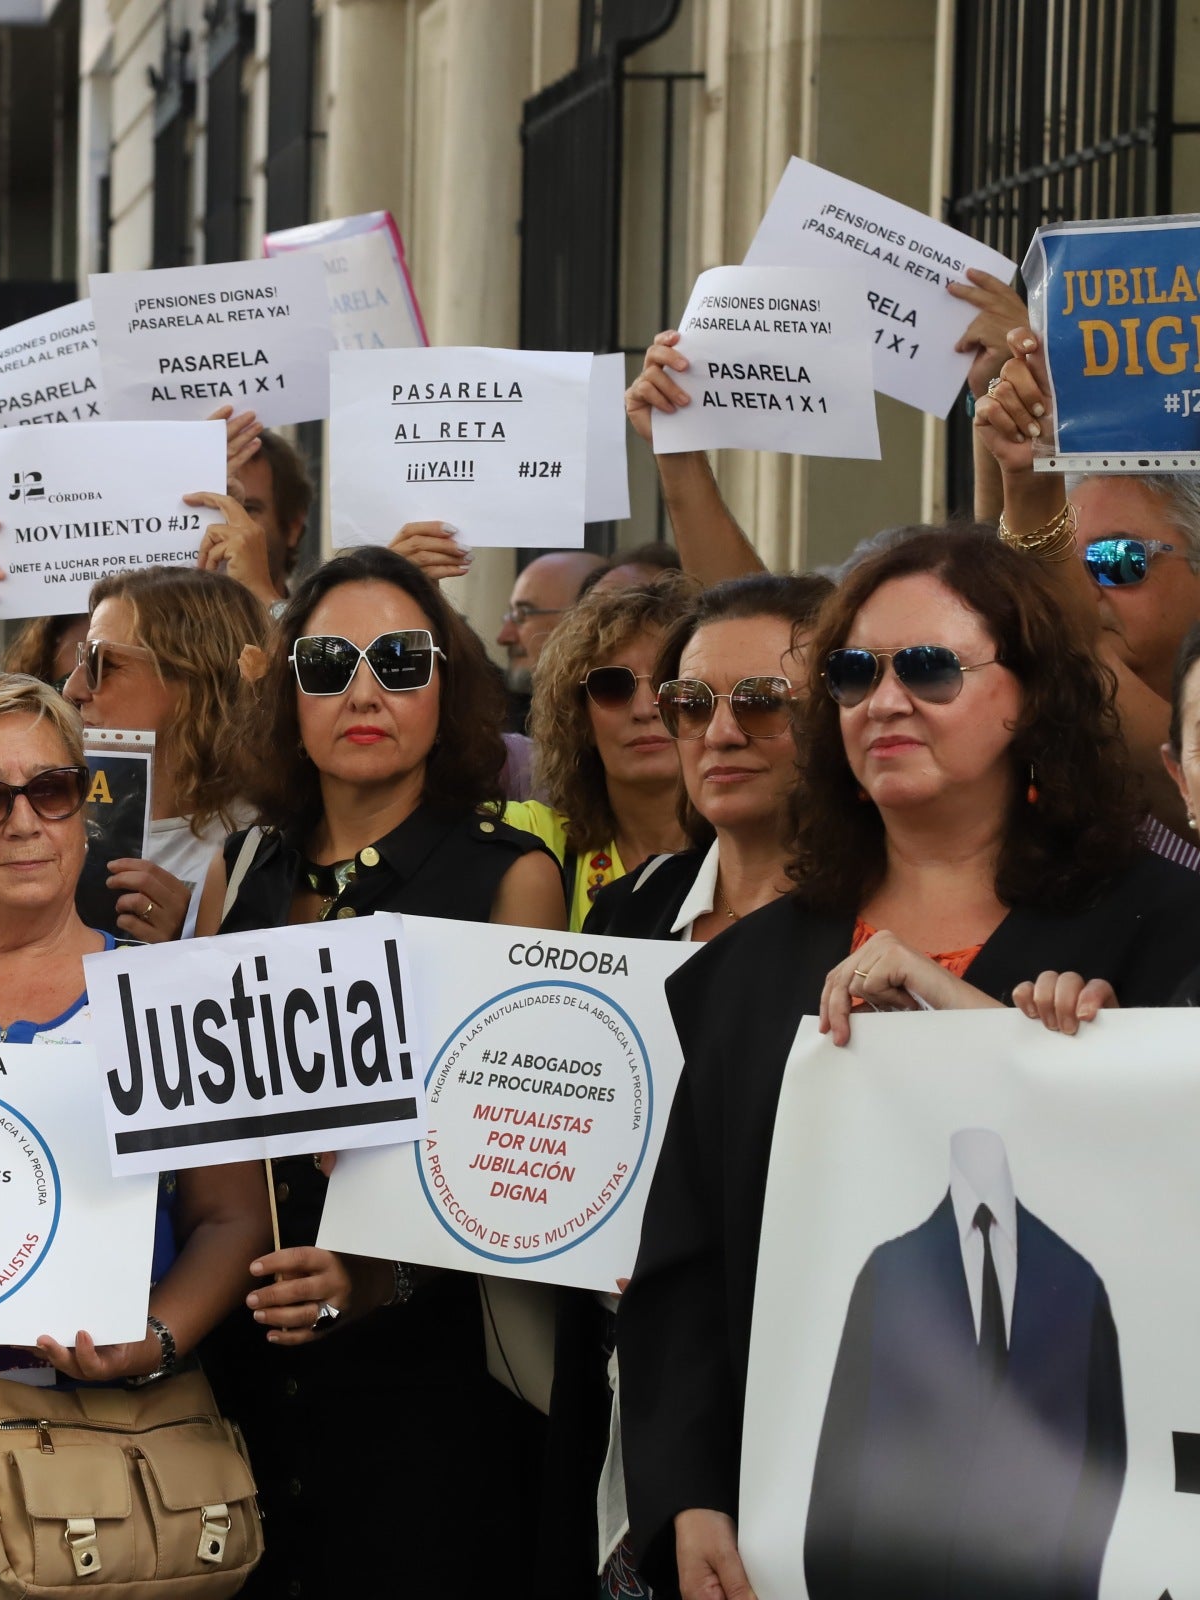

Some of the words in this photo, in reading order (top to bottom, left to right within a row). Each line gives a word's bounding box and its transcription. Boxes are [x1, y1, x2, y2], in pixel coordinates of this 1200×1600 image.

[821, 204, 906, 246] ¡PENSIONES
[908, 238, 966, 272] DIGNAS!
[802, 218, 880, 258] ¡PASARELA
[883, 251, 901, 268] AL
[904, 260, 940, 285] RETA
[135, 293, 216, 313] ¡PENSIONES
[220, 287, 278, 302] DIGNAS!
[1062, 265, 1200, 315] JUBILA
[769, 298, 821, 312] DIGNAS!
[50, 321, 96, 342] DIGNAS
[128, 315, 204, 333] ¡PASARELA
[206, 313, 224, 324] AL
[228, 308, 264, 321] RETA
[267, 305, 290, 317] YA!
[754, 320, 770, 332] AL
[774, 320, 808, 333] RETA
[811, 322, 832, 334] YA!
[38, 351, 54, 363] AL
[57, 342, 89, 357] RETA
[875, 329, 884, 344] 1
[887, 334, 905, 353] X
[910, 344, 919, 359] 1
[159, 349, 269, 374] PASARELA
[708, 362, 811, 384] PASARELA
[151, 386, 176, 401] AL
[181, 382, 232, 399] RETA
[239, 381, 248, 394] 1
[256, 377, 269, 392] X
[276, 374, 285, 388] 1
[392, 382, 523, 401] PASARELA
[87, 402, 100, 417] X
[702, 391, 728, 407] AL
[731, 392, 782, 410] RETA
[785, 395, 794, 411] 1
[802, 396, 814, 413] X
[819, 398, 828, 414] 1
[395, 424, 421, 440] AL
[440, 422, 506, 438] RETA
[407, 461, 474, 481] ¡¡¡YA!!!
[518, 461, 562, 478] #J2#
[48, 491, 103, 503] CÓRDOBA
[15, 516, 162, 543] MOVIMIENTO
[168, 514, 200, 531] #J2
[9, 562, 41, 574] ÚNETE
[44, 561, 52, 570] A
[55, 557, 99, 570] LUCHAR
[103, 556, 126, 565] POR
[129, 555, 143, 563] EL
[44, 574, 66, 584] UNA
[508, 941, 629, 976] CÓRDOBA
[483, 994, 561, 1026] MUTUALIDADES
[563, 996, 577, 1007] DE
[578, 1000, 590, 1011] LA
[106, 939, 414, 1116] Justicia!
[466, 1023, 483, 1041] LAS
[591, 1007, 629, 1049] ABOGACIA
[431, 1049, 460, 1103] EXIGIMOS
[482, 1049, 508, 1065] #J2
[511, 1053, 602, 1077] ABOGADOS
[629, 1058, 637, 1073] LA
[458, 1070, 483, 1086] #J2
[488, 1075, 615, 1102] PROCURADORES
[632, 1074, 642, 1131] PROCURA
[473, 1103, 593, 1134] MUTUALISTAS
[486, 1131, 523, 1150] POR
[529, 1137, 567, 1157] UNA
[23, 1144, 35, 1157] LA
[32, 1157, 47, 1206] PROCURA
[469, 1153, 575, 1183] JUBILACIÓN
[428, 1155, 486, 1240] PROTECCIÓN
[489, 1230, 509, 1248] DE
[514, 1235, 540, 1250] SUS
[545, 1162, 628, 1244] MUTUALISTAS
[490, 1182, 547, 1204] DIGNA
